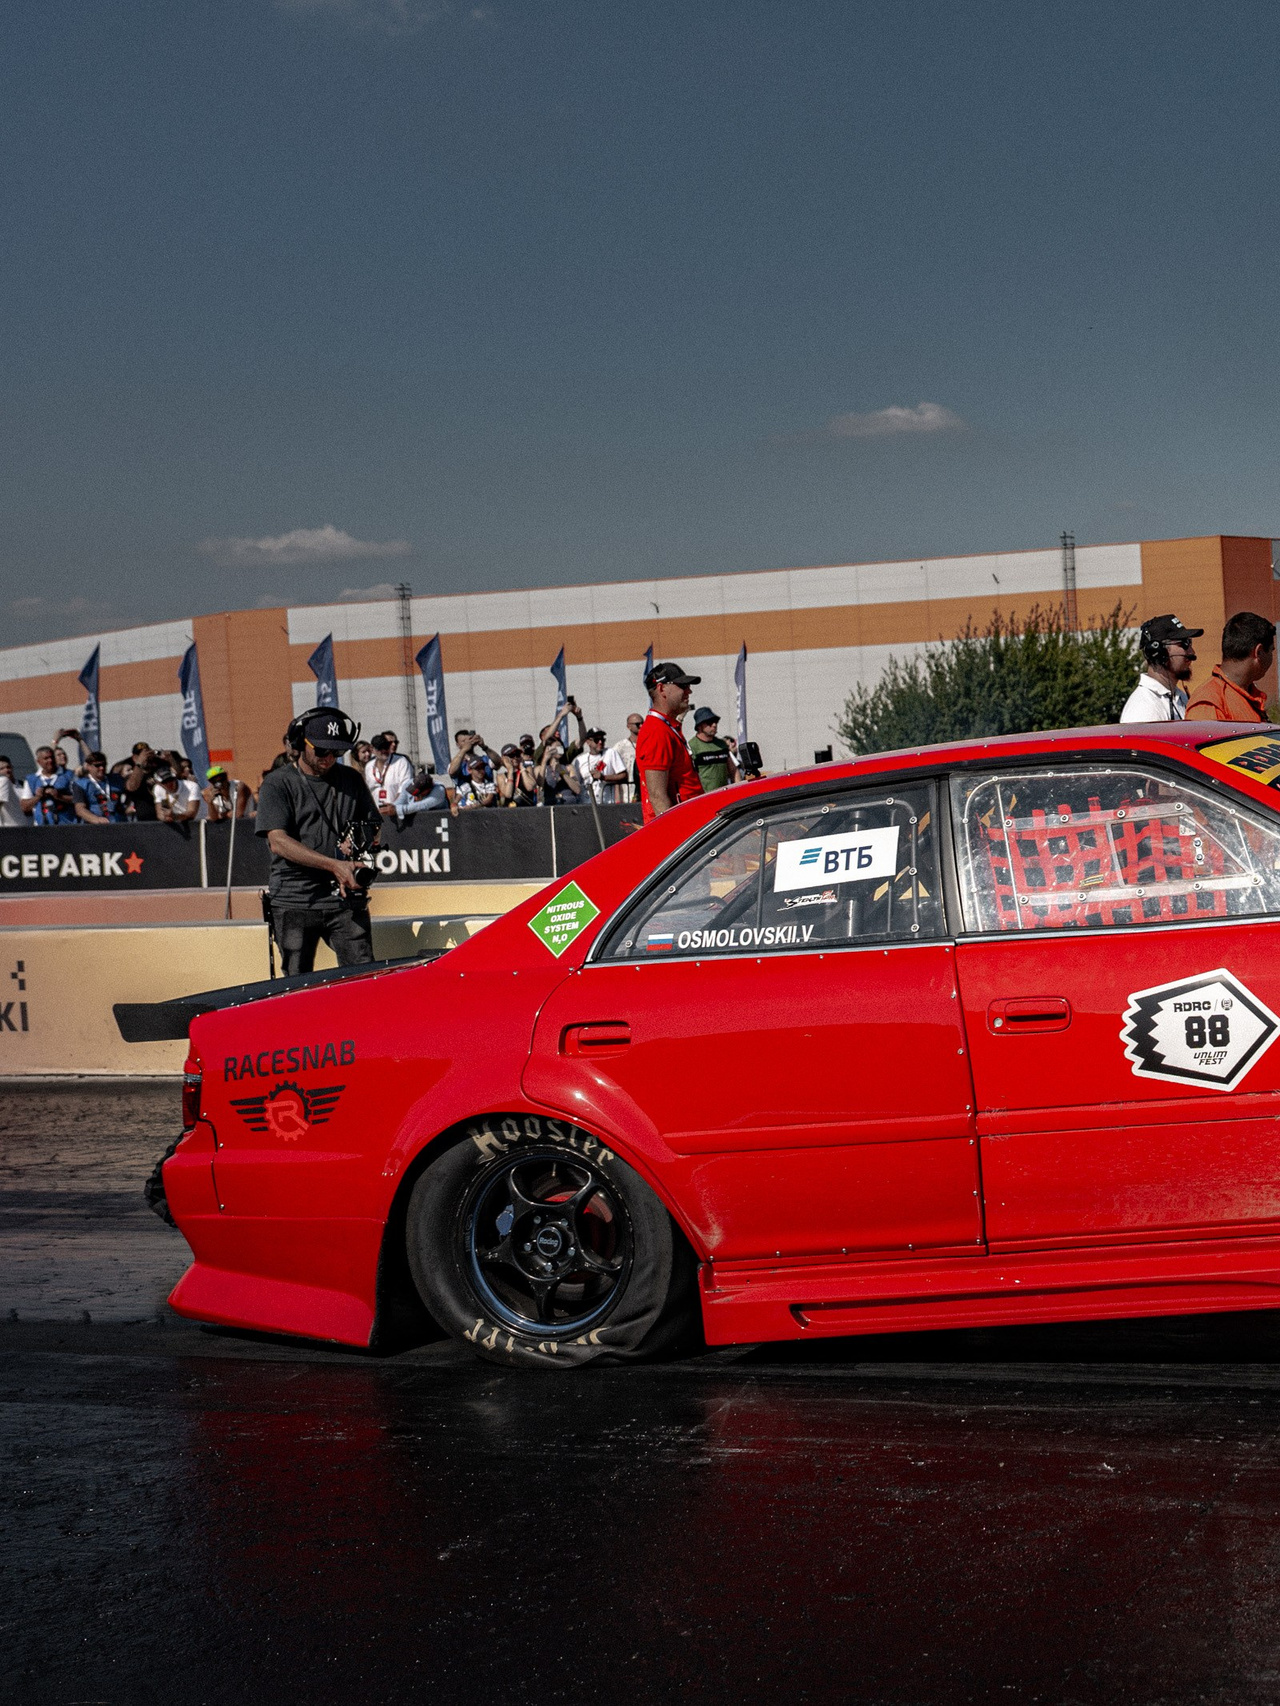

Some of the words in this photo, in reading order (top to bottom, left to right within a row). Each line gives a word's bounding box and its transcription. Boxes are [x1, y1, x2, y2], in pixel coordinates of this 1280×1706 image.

[0, 852, 124, 879] CEPARK
[823, 845, 873, 874] ВТБ
[546, 900, 585, 914] NITROUS
[550, 911, 577, 923] OXIDE
[544, 921, 579, 934] SYSTEM
[677, 924, 815, 949] OSMOLOVSKII.V
[1173, 1000, 1212, 1012] RDRC
[1185, 1014, 1230, 1049] 88
[224, 1039, 355, 1082] RACESNAB
[1198, 1058, 1224, 1066] FEST
